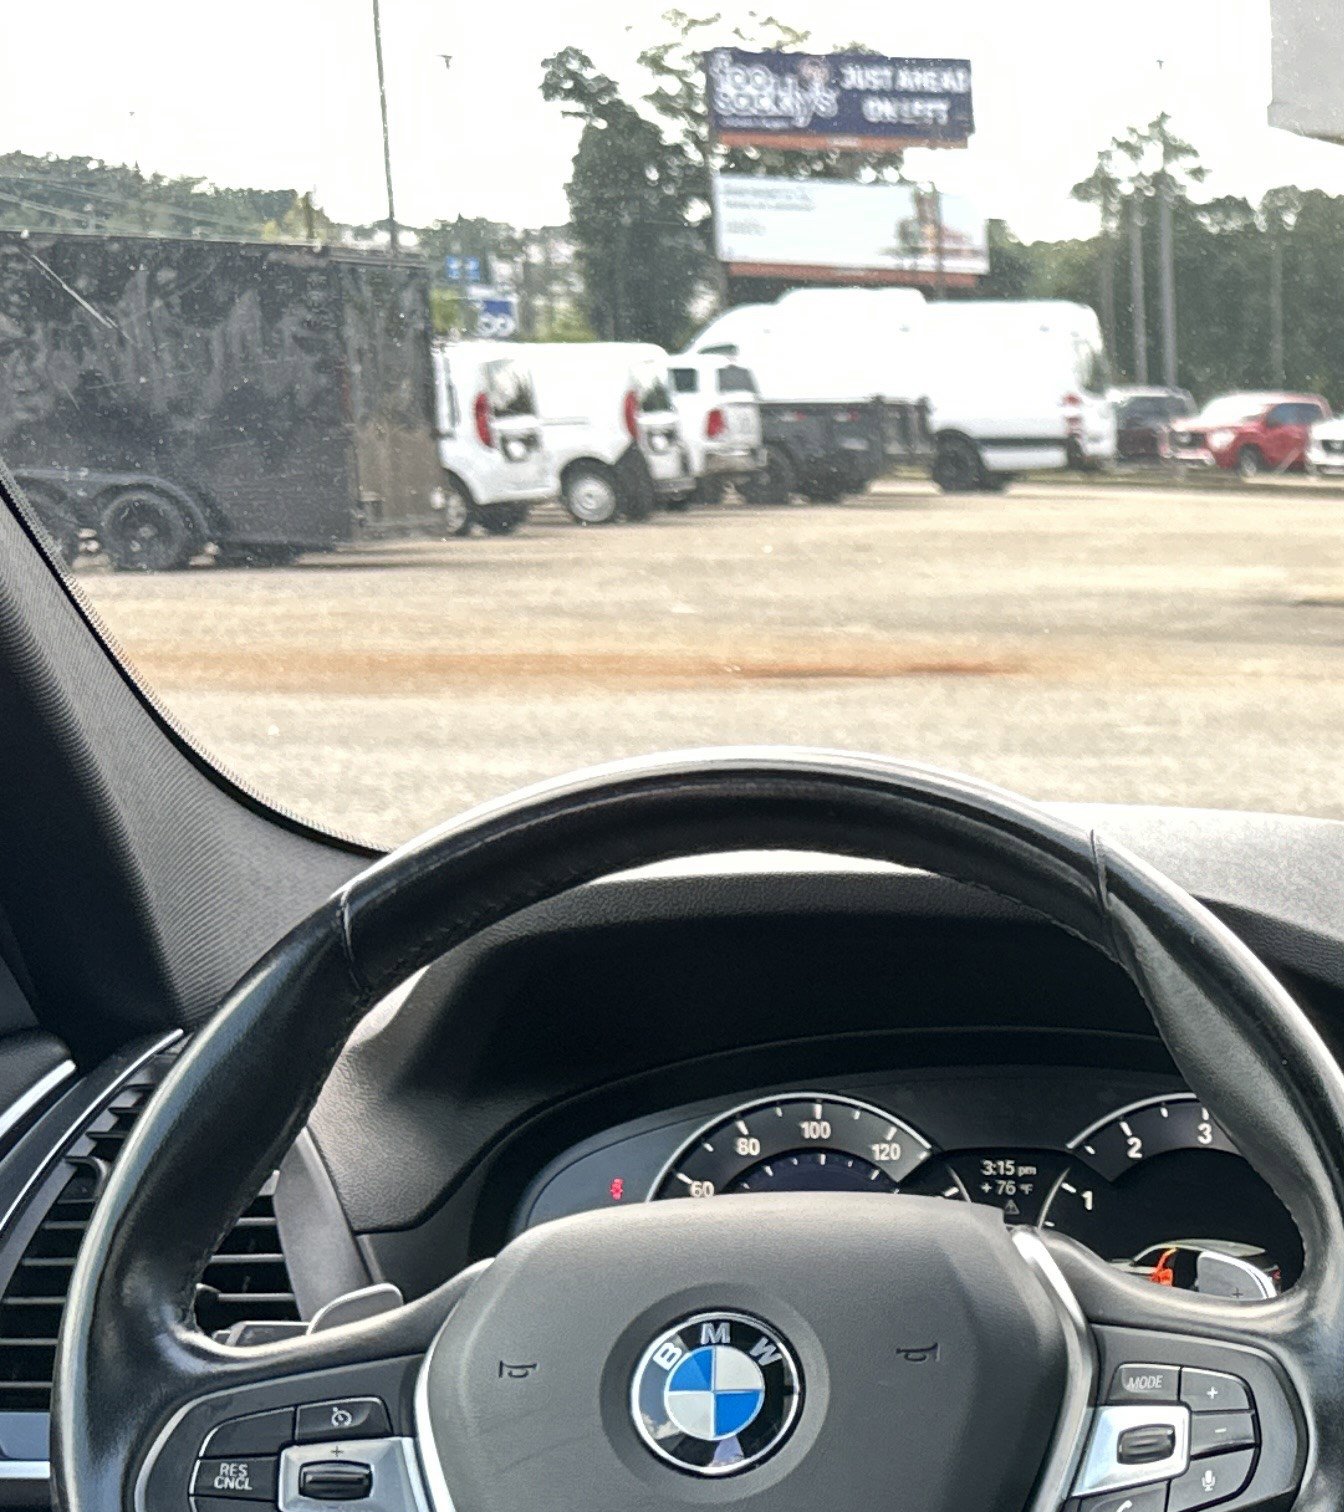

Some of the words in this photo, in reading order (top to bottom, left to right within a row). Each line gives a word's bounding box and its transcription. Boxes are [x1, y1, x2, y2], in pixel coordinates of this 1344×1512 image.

[800, 1120, 832, 1141] 100
[1197, 1123, 1213, 1145] 3
[735, 1137, 761, 1157] 80
[871, 1142, 902, 1162] 120
[1126, 1137, 1143, 1159] 2
[982, 1159, 1016, 1177] 3:15
[1017, 1163, 1037, 1179] pm
[688, 1180, 715, 1198] 60
[995, 1179, 1017, 1196] 76
[1082, 1190, 1094, 1211] 1
[654, 1322, 783, 1372] BMW
[1126, 1374, 1164, 1390] MODE
[219, 1463, 248, 1478] RES
[213, 1475, 253, 1491] CNCL
